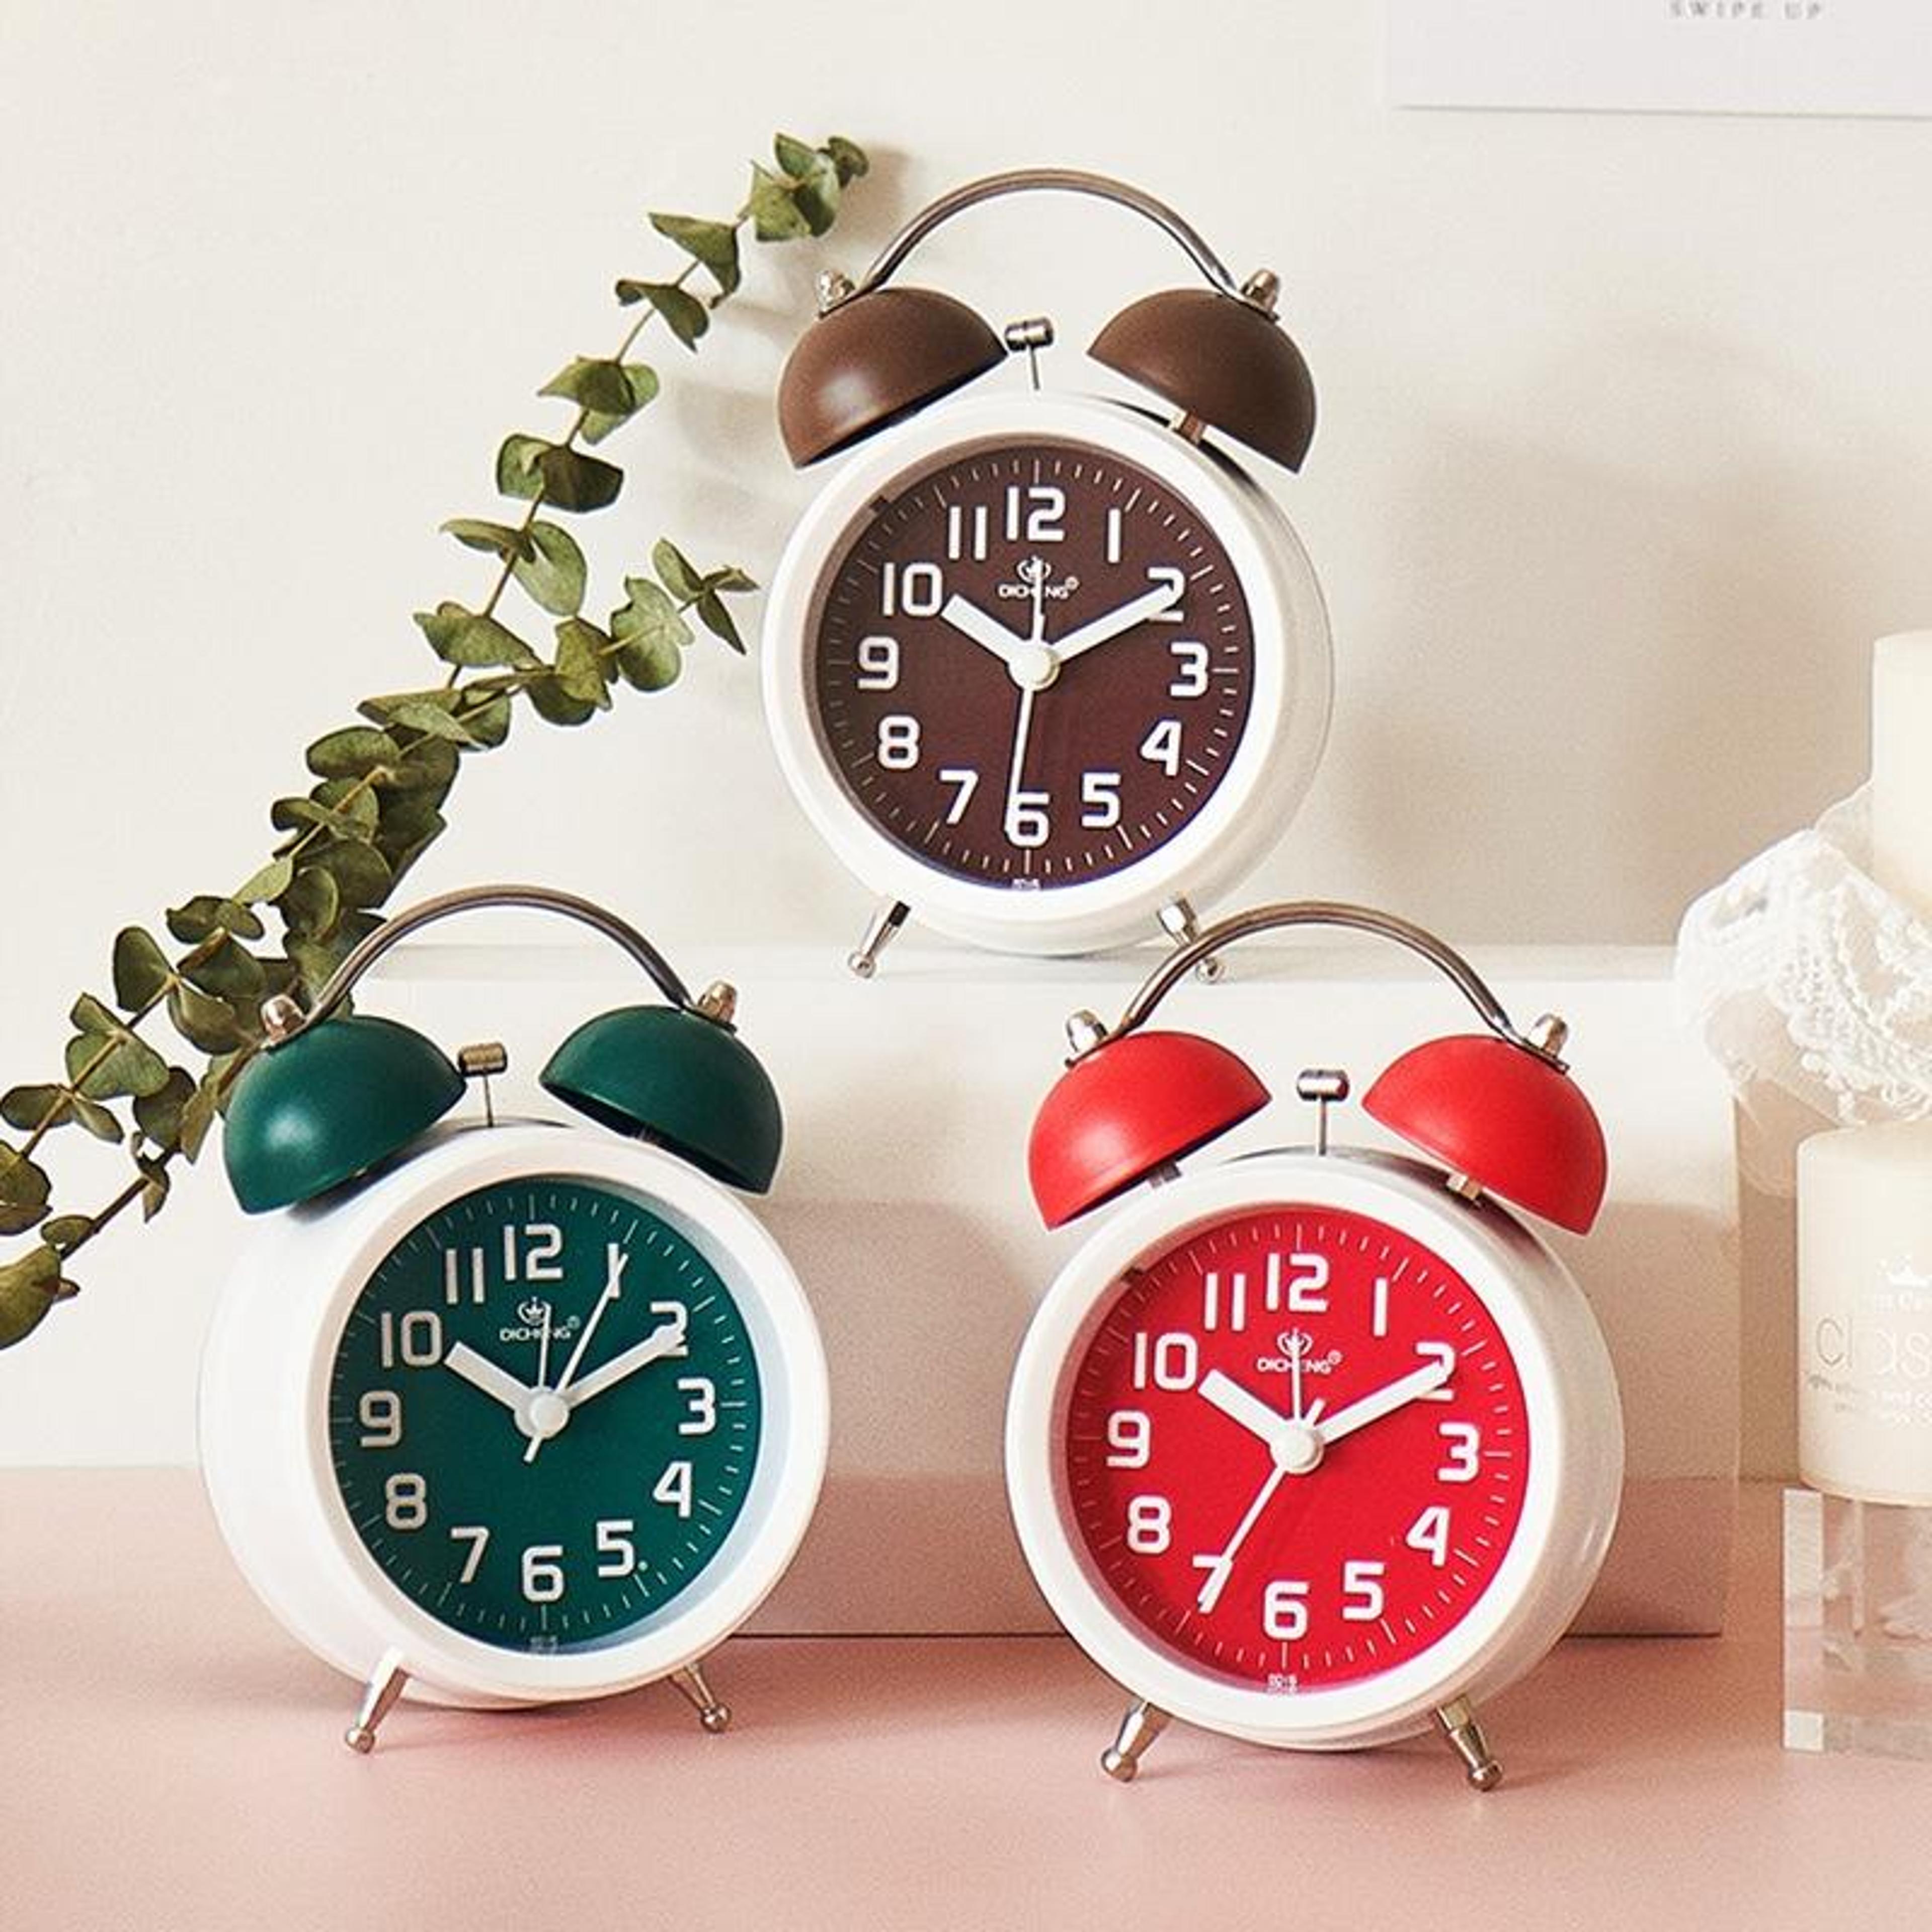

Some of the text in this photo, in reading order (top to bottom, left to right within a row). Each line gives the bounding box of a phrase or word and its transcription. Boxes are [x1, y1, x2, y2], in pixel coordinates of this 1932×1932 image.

[1669, 0, 1821, 20] SWIPE UP
[949, 507, 987, 559] 11
[1007, 487, 1065, 541] 12
[1108, 509, 1120, 563] 1
[883, 563, 942, 616] 10
[999, 584, 1069, 600] DICHNG
[1147, 567, 1185, 622] 2
[858, 637, 899, 689] 9
[1171, 642, 1208, 696] 3
[879, 716, 919, 769] 8
[1141, 721, 1181, 775] 4
[940, 770, 978, 824] 7
[1008, 792, 1050, 847] 6
[1082, 773, 1120, 827] 5
[446, 1248, 484, 1304] 11
[504, 1224, 562, 1280] 12
[608, 1243, 620, 1298] 1
[1205, 1273, 1245, 1331] 11
[1266, 1253, 1328, 1312] 12
[1374, 1278, 1387, 1336] 1
[382, 1311, 442, 1367] 10
[500, 1327, 571, 1342] DICHNG
[651, 1301, 688, 1356] 2
[1135, 1333, 1197, 1390] 10
[1257, 1357, 1331, 1374] DICHNG
[1417, 1342, 1456, 1401] 2
[360, 1391, 401, 1446] 9
[678, 1378, 715, 1434] 3
[1107, 1411, 1150, 1468] 9
[1438, 1423, 1479, 1481] 3
[386, 1474, 426, 1528] 8
[653, 1462, 692, 1517] 4
[596, 1520, 634, 1577] 5
[1128, 1496, 1171, 1553] 8
[1406, 1507, 1450, 1566] 4
[451, 1526, 489, 1582] 7
[522, 1545, 564, 1601] 6
[1193, 1555, 1233, 1613] 7
[1264, 1581, 1308, 1639] 6
[1343, 1561, 1384, 1620] 5
